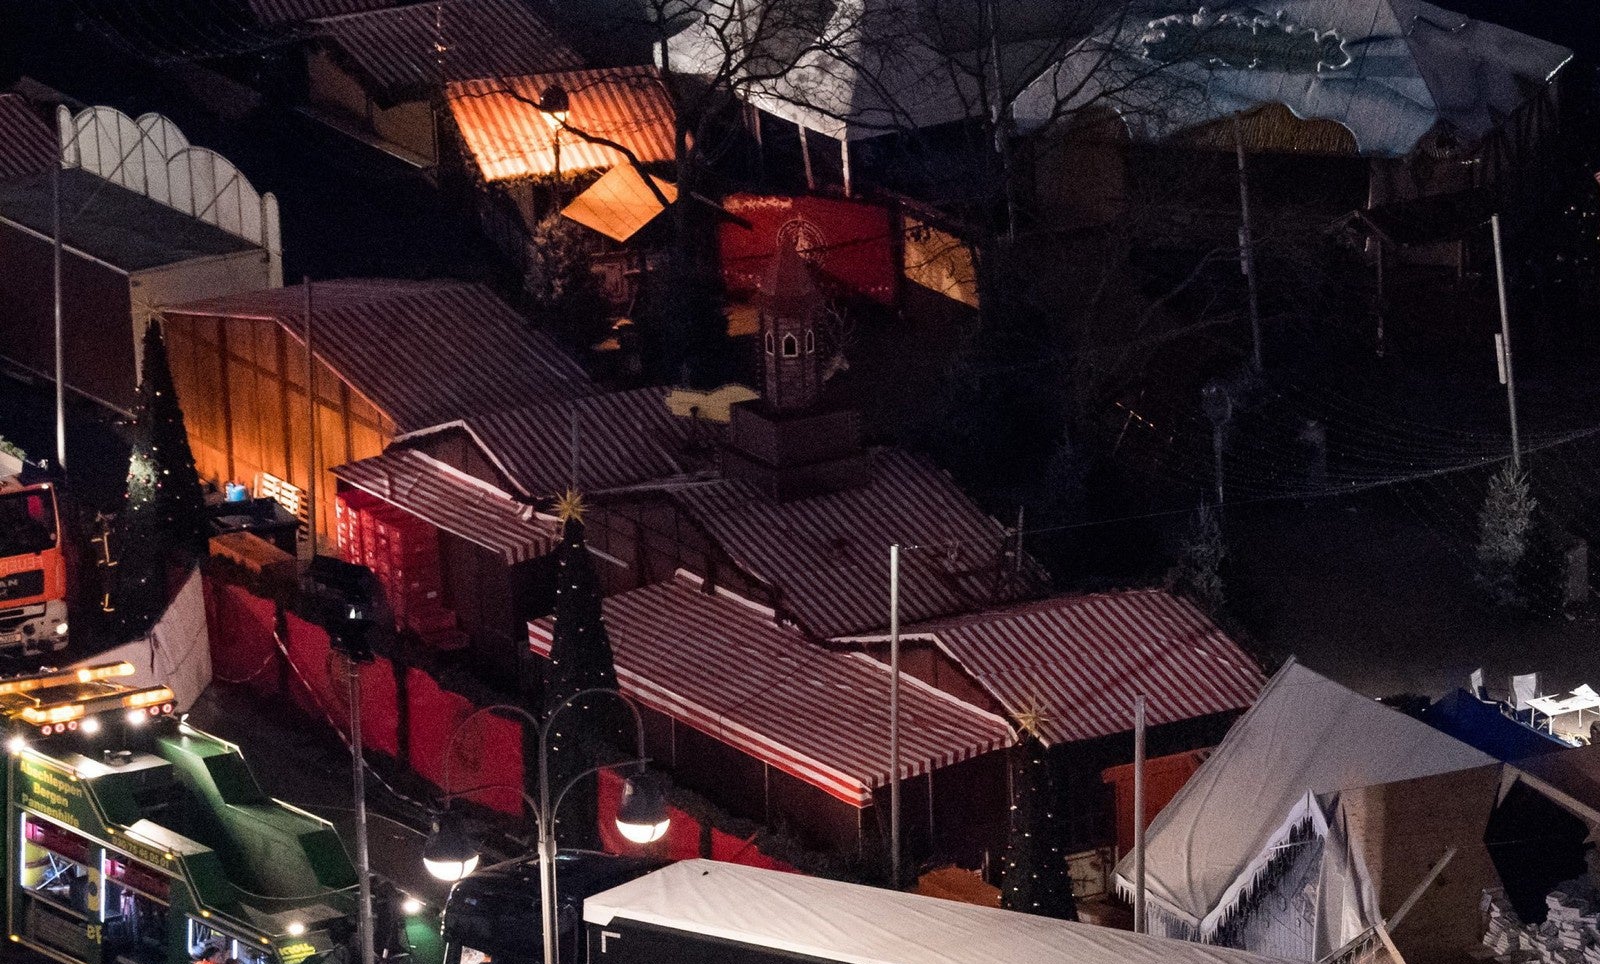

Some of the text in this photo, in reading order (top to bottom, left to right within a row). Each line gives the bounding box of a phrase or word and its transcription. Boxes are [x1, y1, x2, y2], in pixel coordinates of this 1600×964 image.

[20, 761, 83, 798] Abschleppen
[33, 781, 69, 808] Bergen
[22, 793, 80, 827] Pannenhilfe
